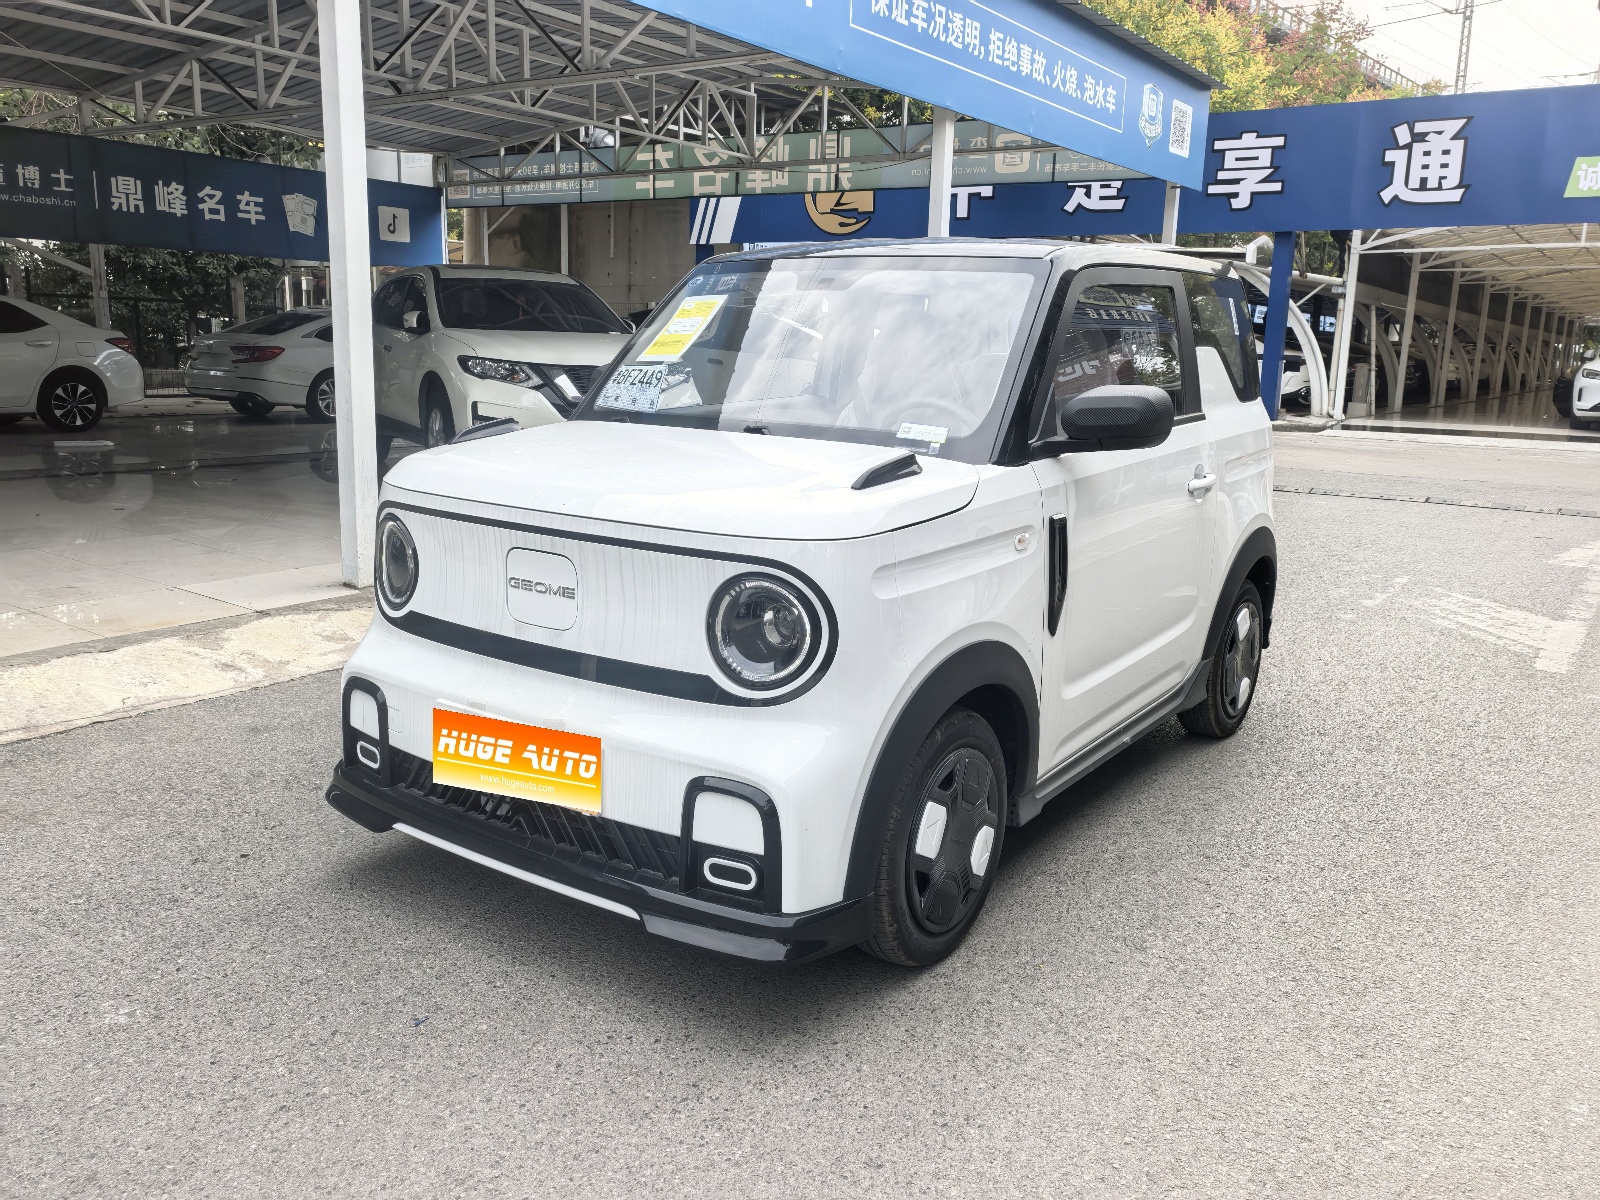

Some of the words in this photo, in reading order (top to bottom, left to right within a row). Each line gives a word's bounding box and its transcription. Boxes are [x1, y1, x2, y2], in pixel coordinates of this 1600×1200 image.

[0, 164, 74, 192] 博士
[110, 175, 266, 226] 鼎峰名车
[508, 576, 576, 600] GEOME
